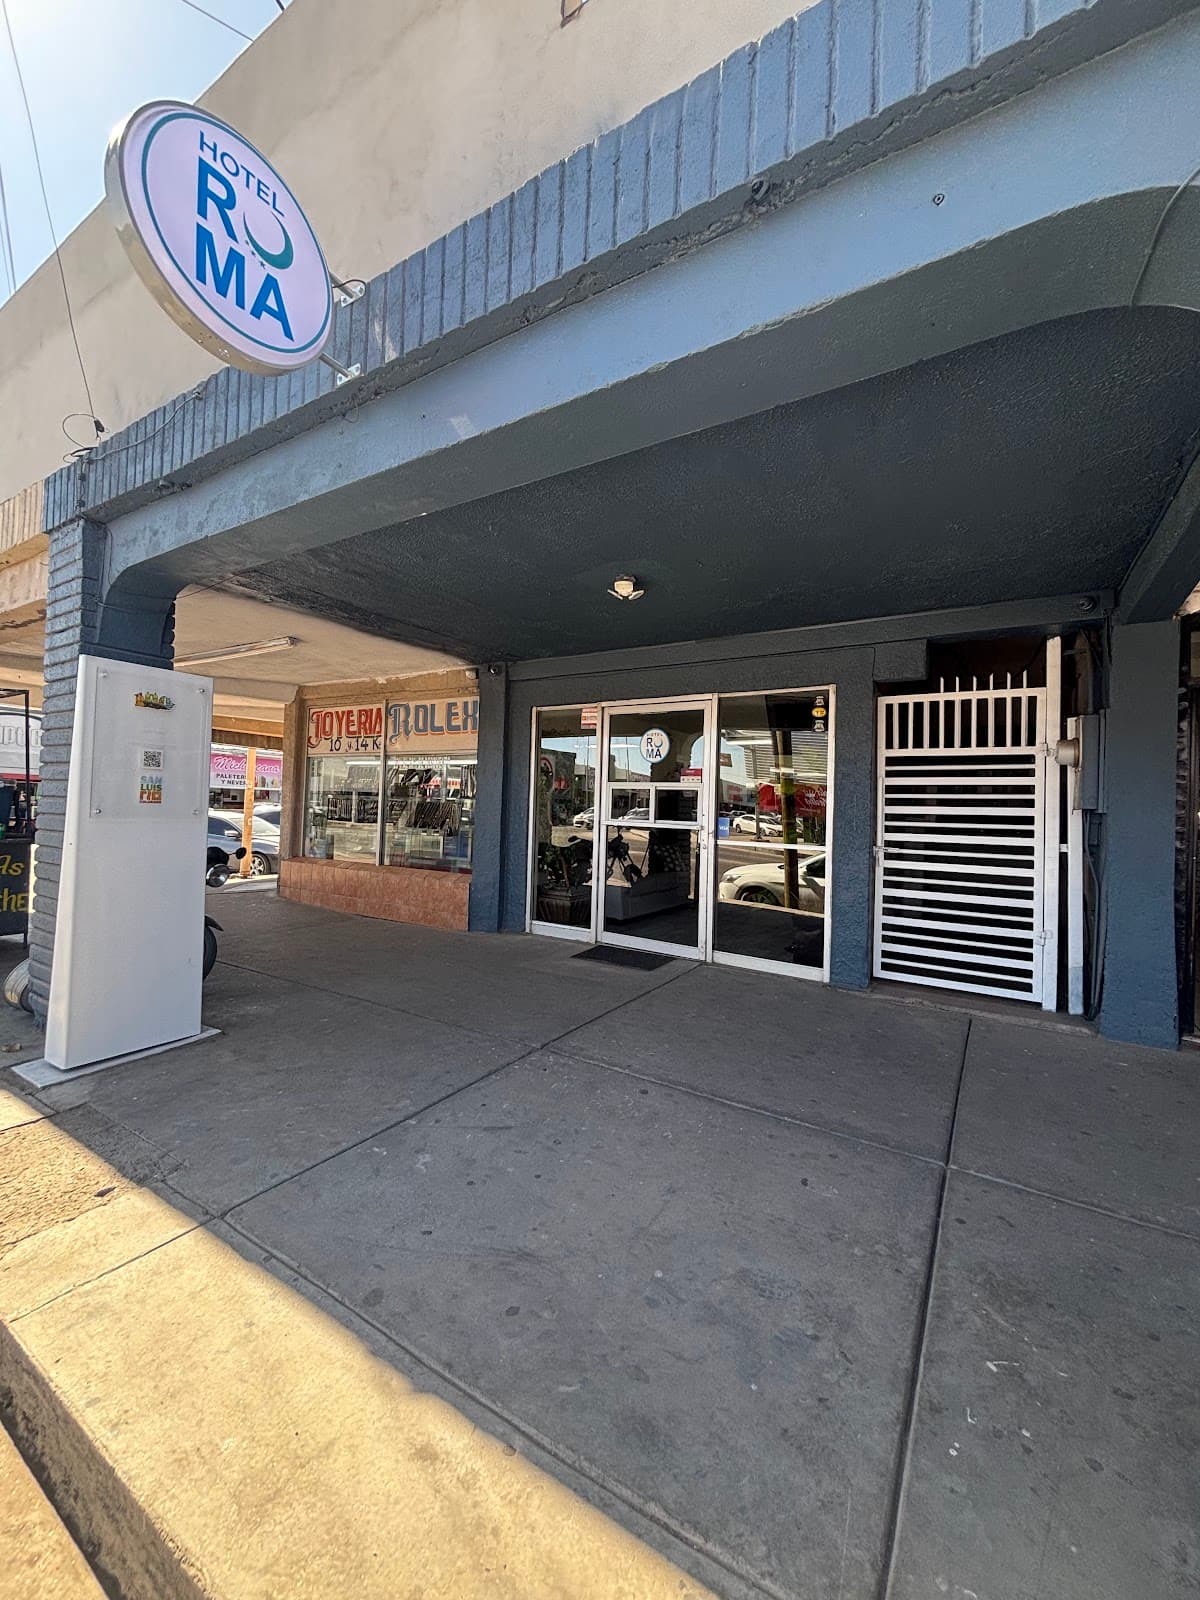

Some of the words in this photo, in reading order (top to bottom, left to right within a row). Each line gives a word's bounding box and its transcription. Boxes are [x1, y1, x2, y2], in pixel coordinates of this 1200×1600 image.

[199, 130, 285, 217] HOTEL
[307, 707, 383, 749] JOYERIA
[387, 699, 479, 746] ROLEX
[329, 738, 342, 752] 10
[354, 737, 369, 752] 14
[140, 775, 162, 784] SAN
